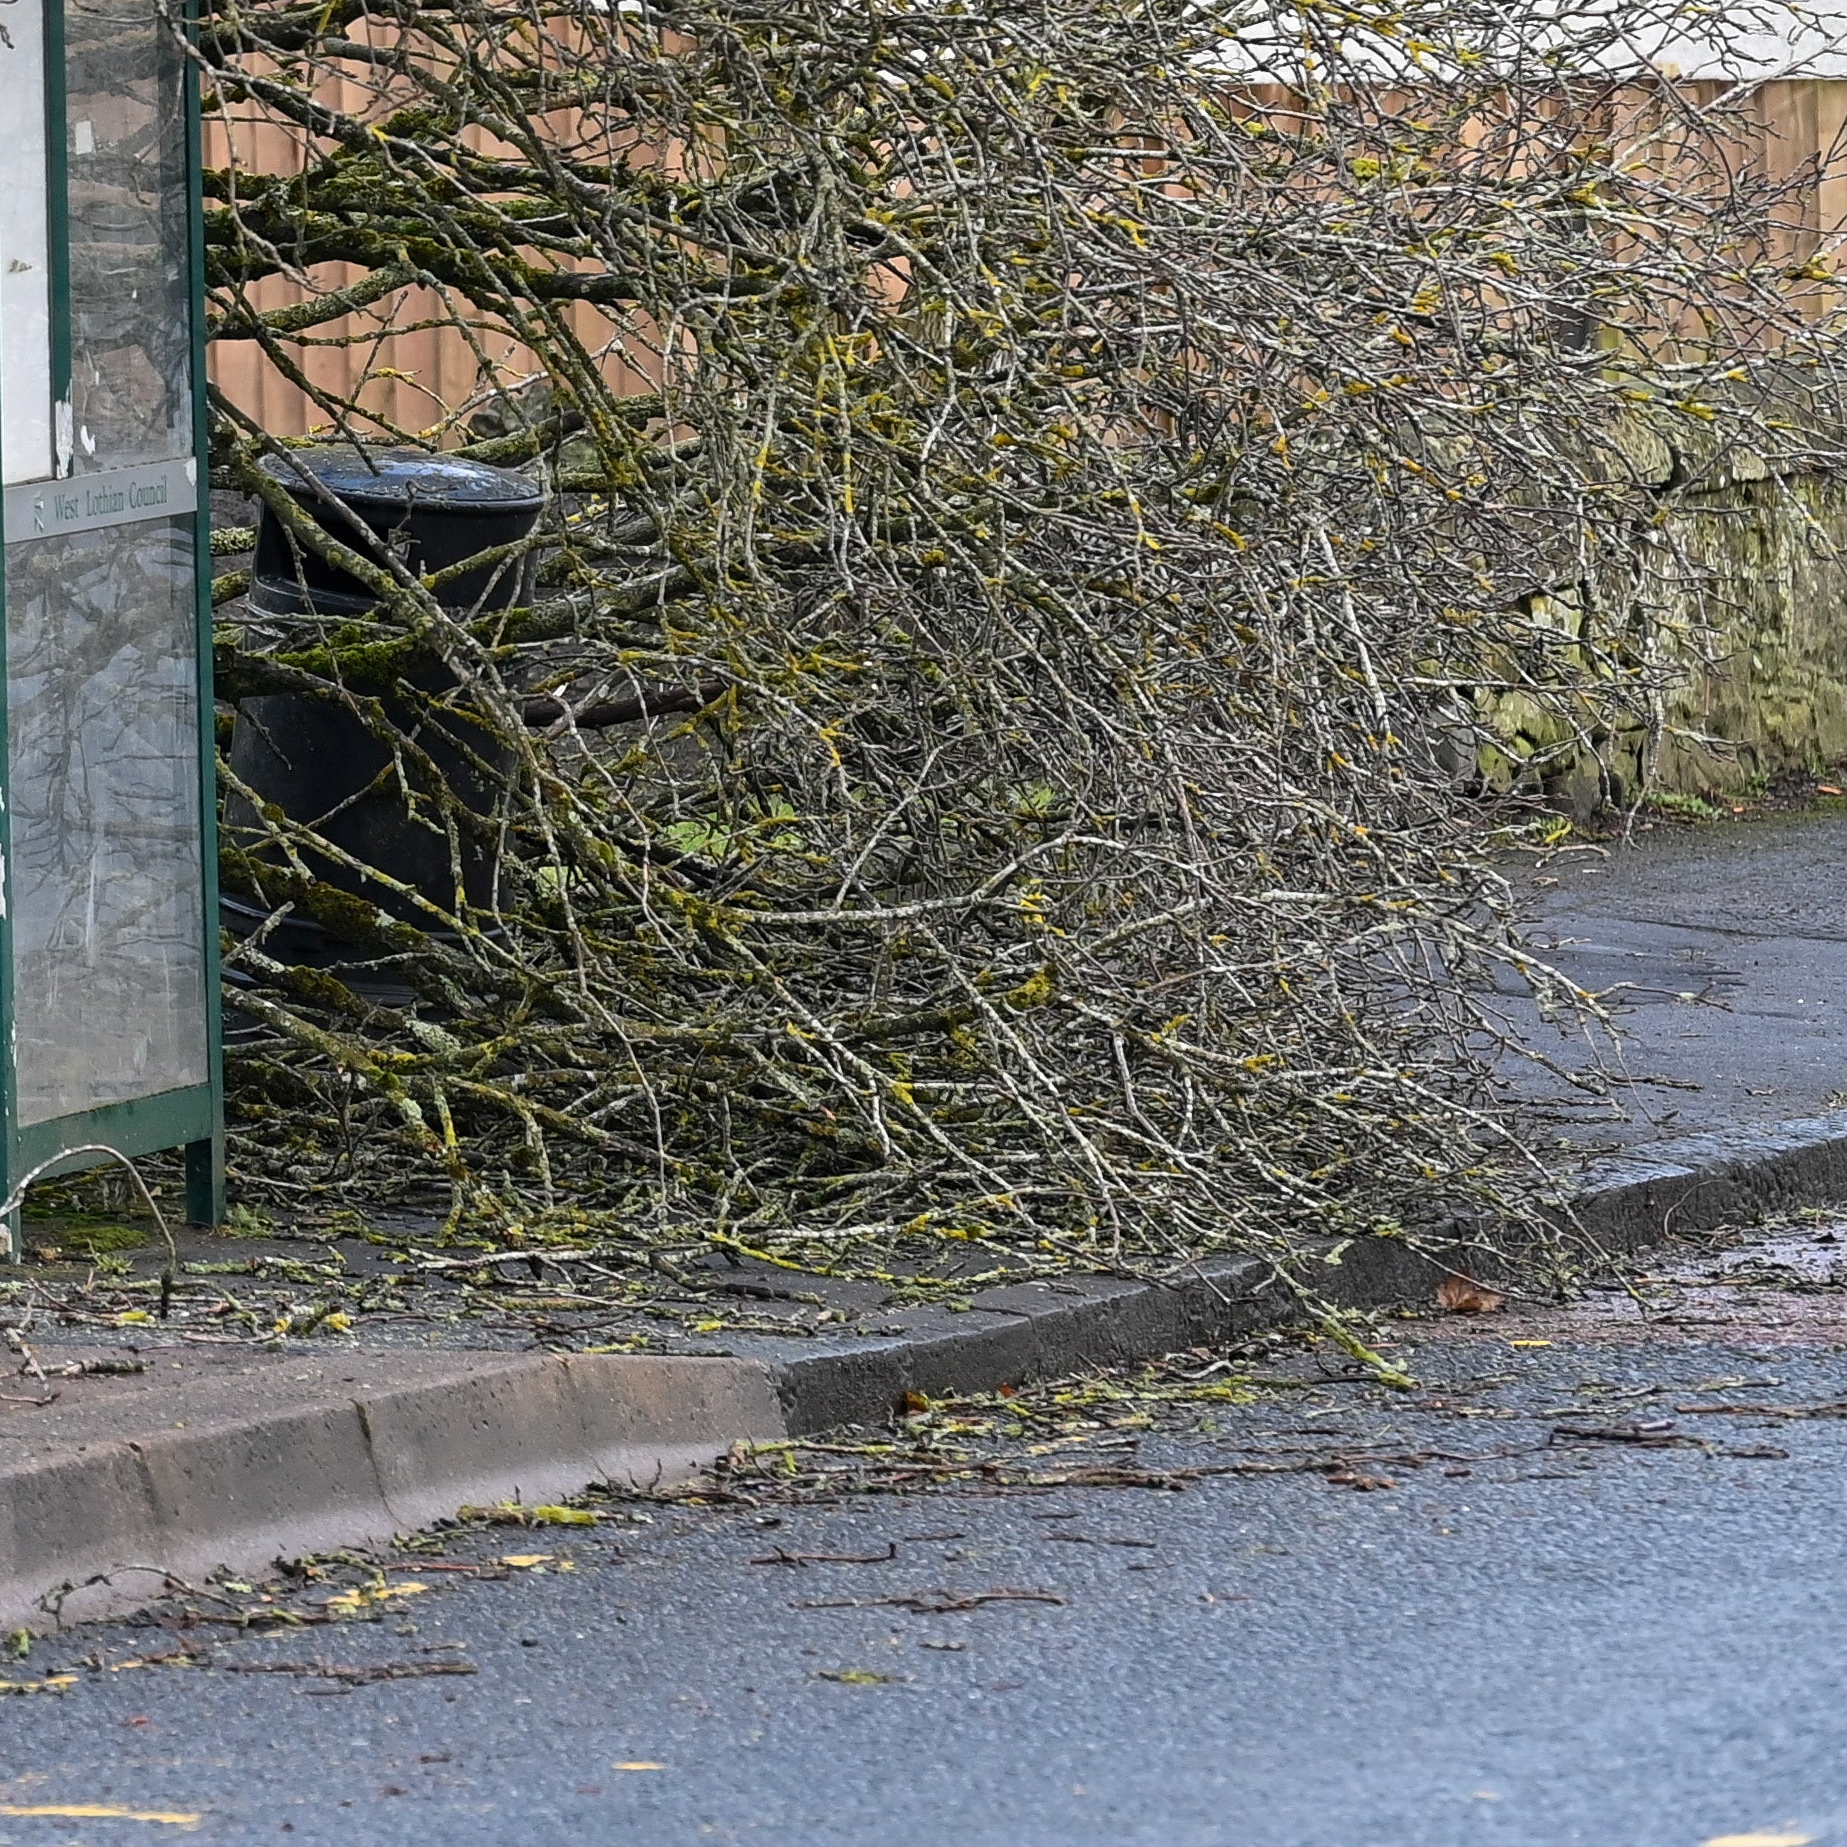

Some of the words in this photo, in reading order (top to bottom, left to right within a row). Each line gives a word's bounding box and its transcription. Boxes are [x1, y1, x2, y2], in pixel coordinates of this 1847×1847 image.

[54, 494, 80, 521] West
[86, 484, 125, 517] Lothian
[129, 474, 168, 510] Council
